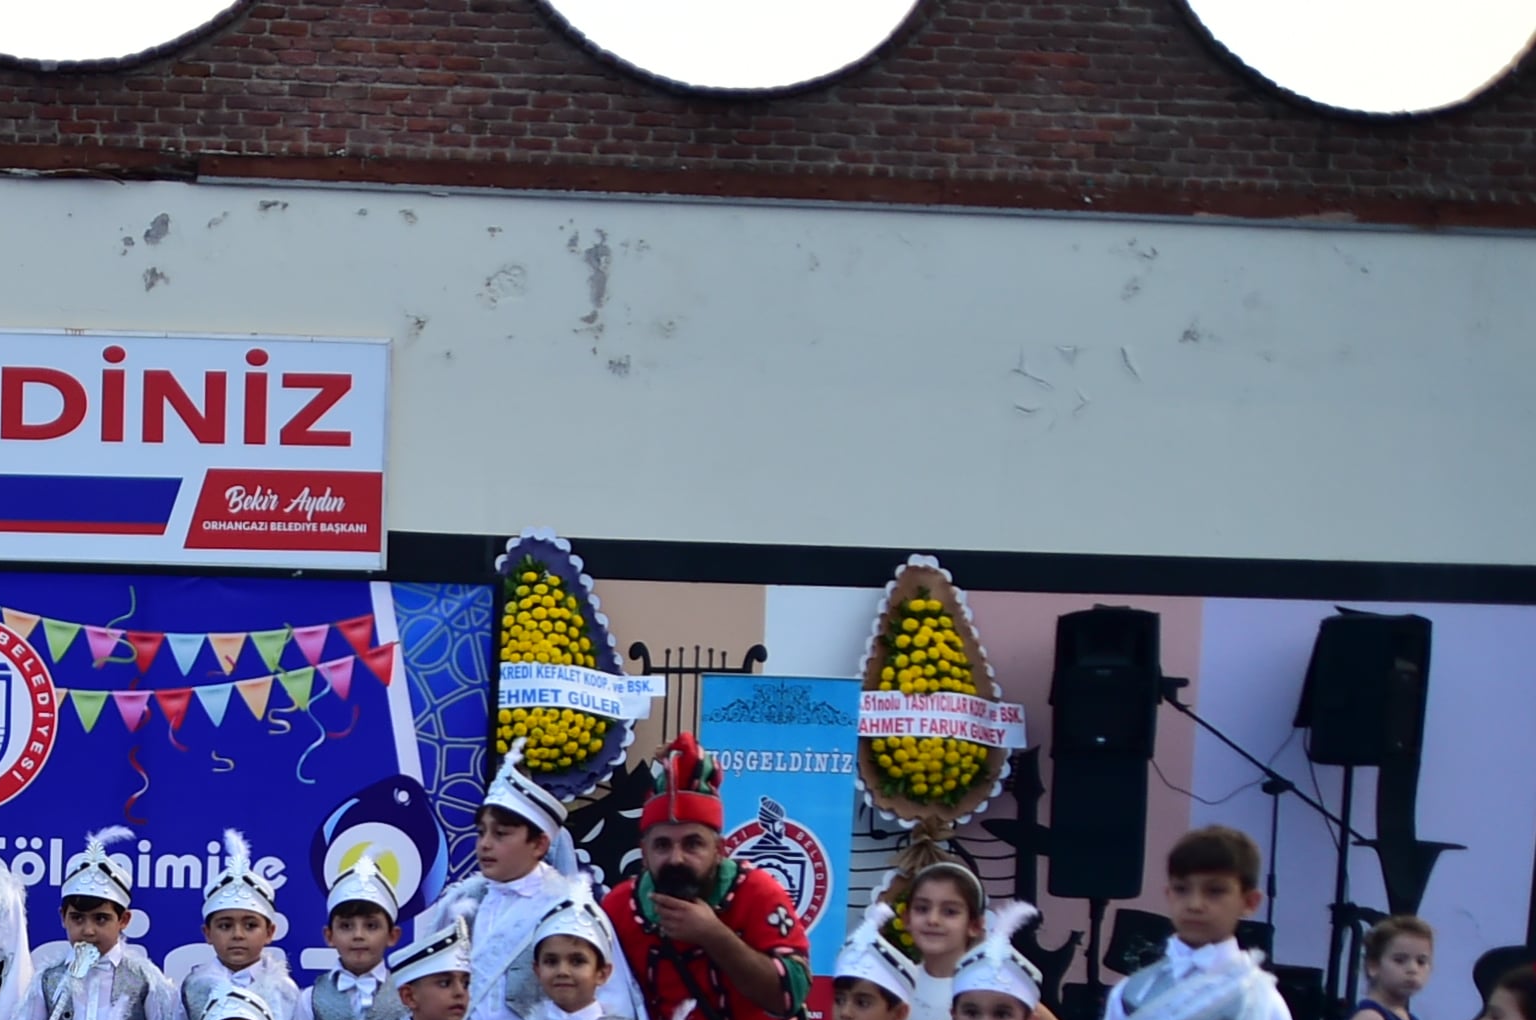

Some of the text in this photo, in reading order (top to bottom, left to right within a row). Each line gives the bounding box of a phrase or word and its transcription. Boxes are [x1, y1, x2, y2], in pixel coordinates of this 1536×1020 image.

[224, 485, 346, 521] Bekir Aydın
[319, 522, 367, 535] BAŞKANI
[567, 690, 621, 716] GÜLER
[859, 717, 914, 734] AHMET
[919, 717, 969, 737] FARUK
[795, 830, 827, 924] BELEDİYES
